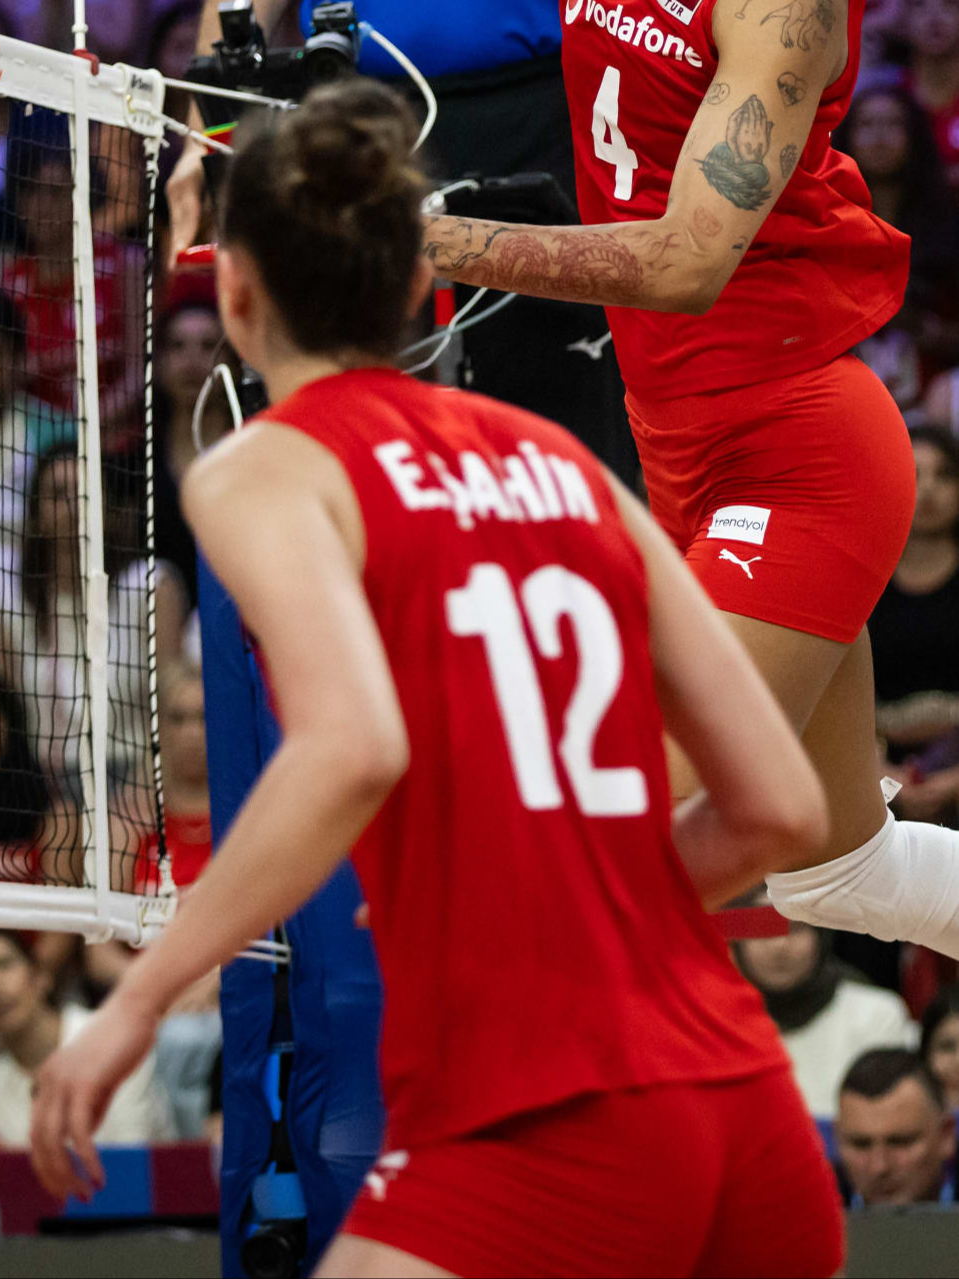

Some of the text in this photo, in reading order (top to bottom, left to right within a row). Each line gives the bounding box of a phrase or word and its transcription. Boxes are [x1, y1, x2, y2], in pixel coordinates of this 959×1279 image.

[591, 65, 639, 202] 4
[714, 517, 766, 532] trendyol
[444, 562, 650, 817] 12
